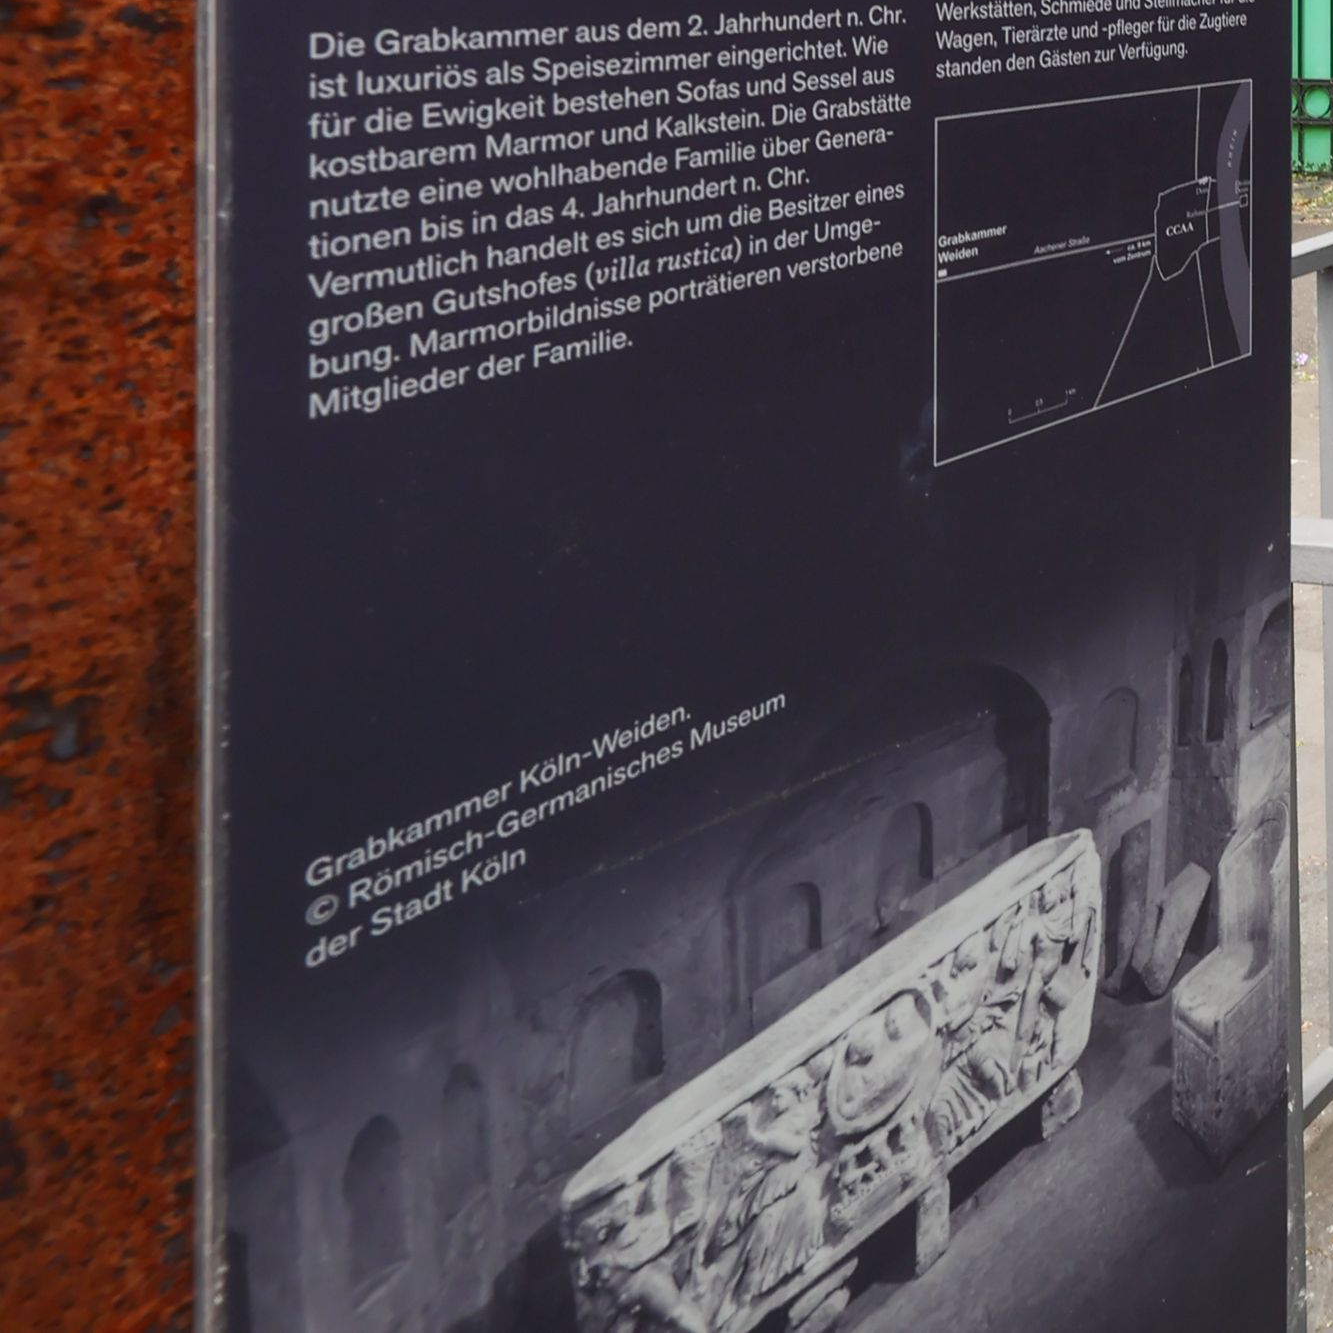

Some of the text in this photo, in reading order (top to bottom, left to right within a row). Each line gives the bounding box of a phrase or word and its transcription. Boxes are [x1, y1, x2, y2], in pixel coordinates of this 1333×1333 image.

[935, 0, 1037, 22] Werkstätten,
[935, 41, 1188, 79] standen den Gästen zur Verfügung.
[309, 93, 912, 180] kostbarem Marmor und Kalkstein. Die Grabstätte
[309, 127, 894, 220] nutzte eine wohlhabende Familie über Genera-
[938, 224, 1008, 248] Grabkammer
[938, 246, 979, 264] Weiden
[309, 241, 903, 380] bung. Marmorbildnisse porträtieren verstorbene
[309, 328, 633, 419] Mitglieder der Familie.
[305, 706, 691, 887] Grabkammer Köln-Weiden.
[349, 740, 684, 908] Römisch-Germanisches
[690, 693, 786, 750] Museum
[305, 848, 526, 968] der Stadt Köln
